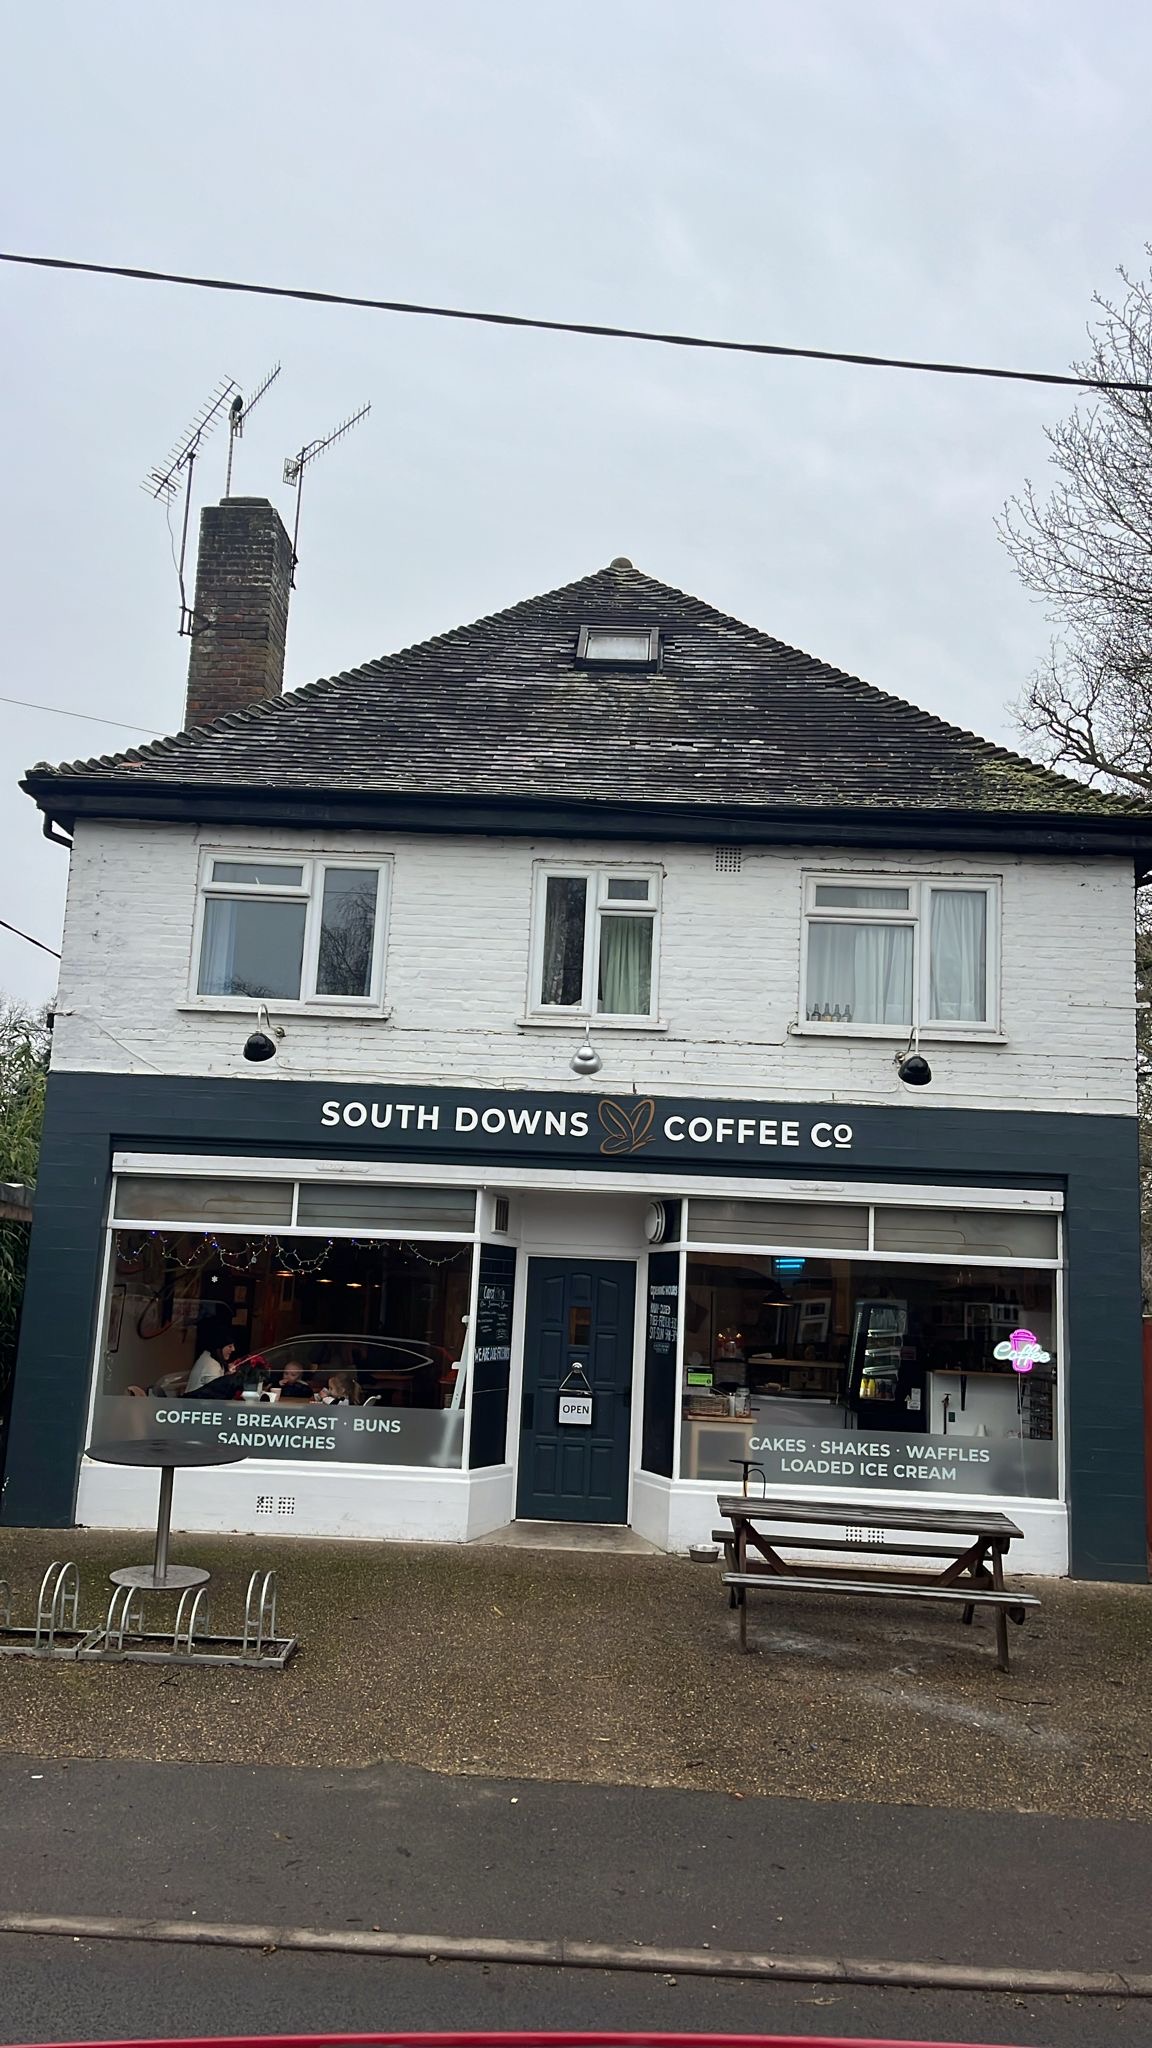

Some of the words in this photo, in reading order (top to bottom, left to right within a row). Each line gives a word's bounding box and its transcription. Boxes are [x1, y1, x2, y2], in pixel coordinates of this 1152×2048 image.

[320, 1100, 440, 1131] SOUTH
[455, 1107, 589, 1137] DOWNS
[663, 1115, 800, 1147] COFFEE
[993, 1341, 1051, 1366] Coffee
[562, 1404, 590, 1414] OPEN
[155, 1410, 223, 1426] COFFEE
[236, 1413, 338, 1430] BREAKFAST
[353, 1418, 401, 1433] BUNS
[217, 1432, 336, 1450] SANDWICHES
[748, 1437, 807, 1452] CAKES
[820, 1441, 891, 1457] SHAKES
[906, 1445, 990, 1463] WAFFLES
[780, 1458, 854, 1476] LOADED
[860, 1463, 888, 1477] ICE
[893, 1465, 957, 1480] CREAM
